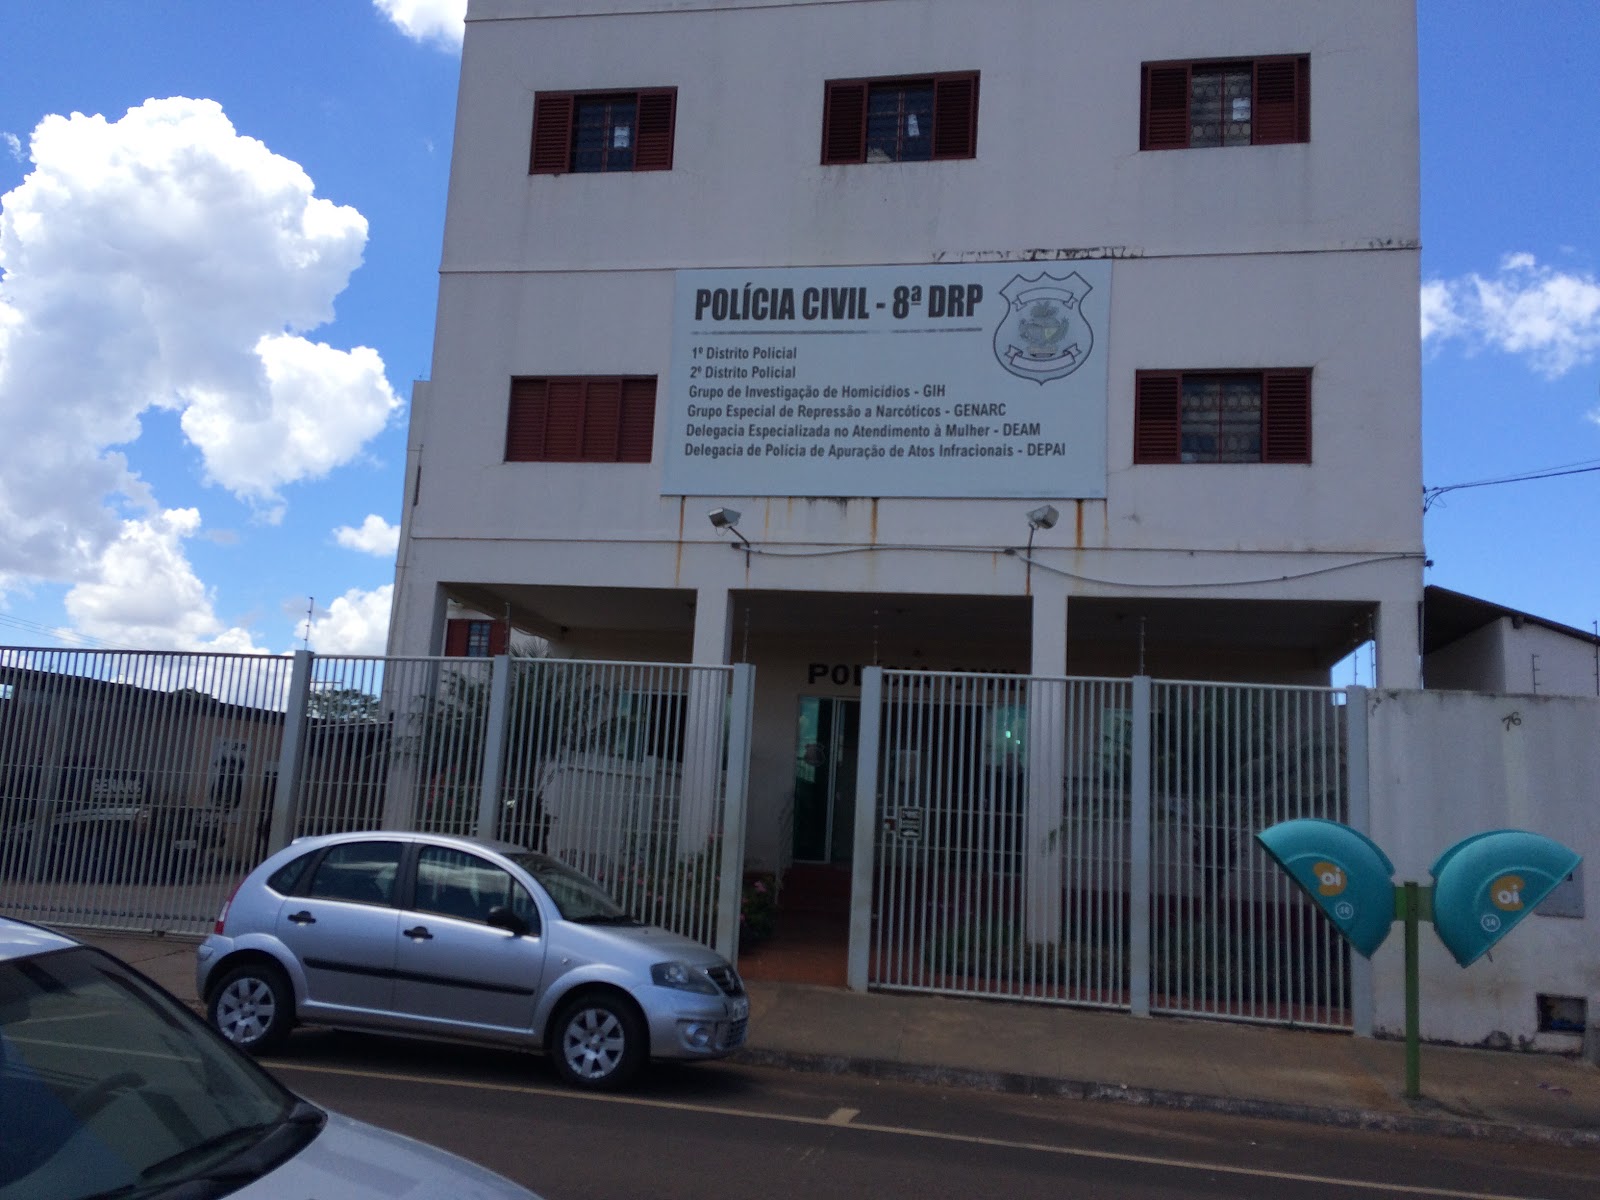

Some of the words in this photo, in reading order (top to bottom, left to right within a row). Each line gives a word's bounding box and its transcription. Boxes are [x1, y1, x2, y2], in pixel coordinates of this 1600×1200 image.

[695, 282, 795, 321] POLÍCIA
[802, 287, 869, 320] CIVIL
[893, 285, 922, 319] 8ª
[928, 284, 983, 318] DRP
[706, 347, 749, 360] Distrito
[753, 346, 797, 359] Policial
[705, 366, 748, 379] Distrito
[752, 366, 796, 379] Policial
[689, 385, 724, 402] Grupo
[727, 385, 741, 398] de
[745, 385, 819, 401] Investigação
[823, 385, 838, 398] de
[923, 384, 945, 397] GIH
[687, 404, 722, 420] Grupo
[726, 405, 775, 420] Especial
[779, 405, 793, 418] de
[798, 405, 861, 420] Repressão
[876, 404, 941, 417] Narcóticos
[954, 403, 1006, 417] GENARC
[686, 424, 744, 440] Delegacia
[748, 424, 830, 440] Especializada
[834, 427, 848, 437] no
[852, 424, 930, 438] Atendimento
[946, 424, 990, 437] Mulher
[1002, 422, 1041, 436] DEAM
[685, 443, 743, 459] Delegacia
[746, 443, 761, 457] de
[810, 443, 824, 457] de
[828, 443, 885, 460] Apuração
[889, 443, 904, 457] de
[908, 444, 935, 457] Atos
[939, 443, 1014, 457] Infracionais
[1027, 442, 1066, 457] DEPAI
[808, 663, 932, 688] POLCIA
[1501, 711, 1522, 732] 76
